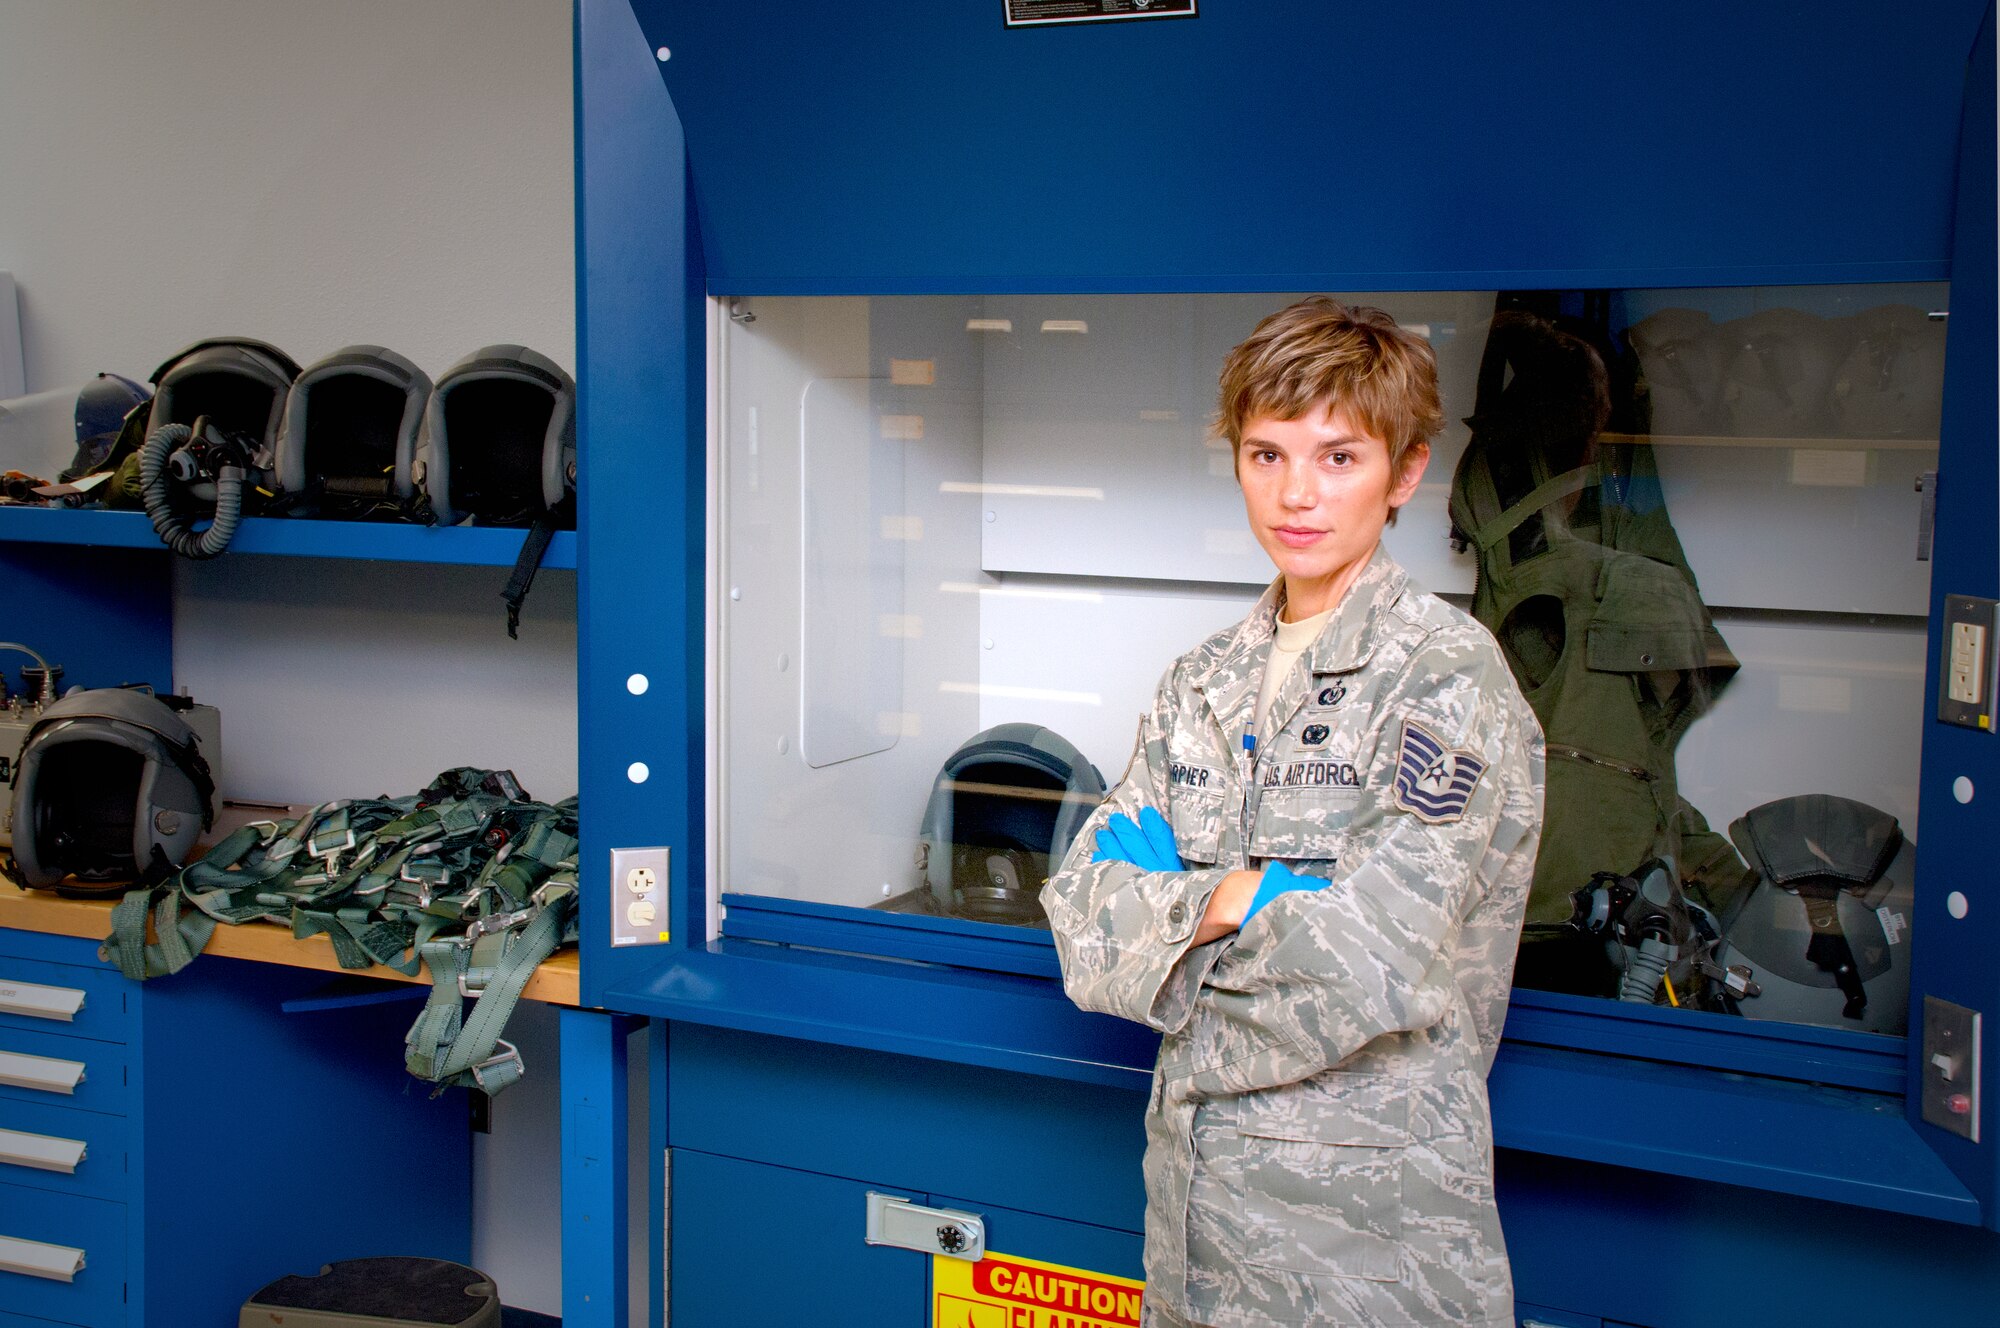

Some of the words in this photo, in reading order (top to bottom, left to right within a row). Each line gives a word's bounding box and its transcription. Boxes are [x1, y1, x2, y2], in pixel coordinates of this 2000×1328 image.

[1169, 764, 1209, 787] RPIER
[1283, 763, 1304, 786] AIR
[989, 1266, 1140, 1321] CAUTION
